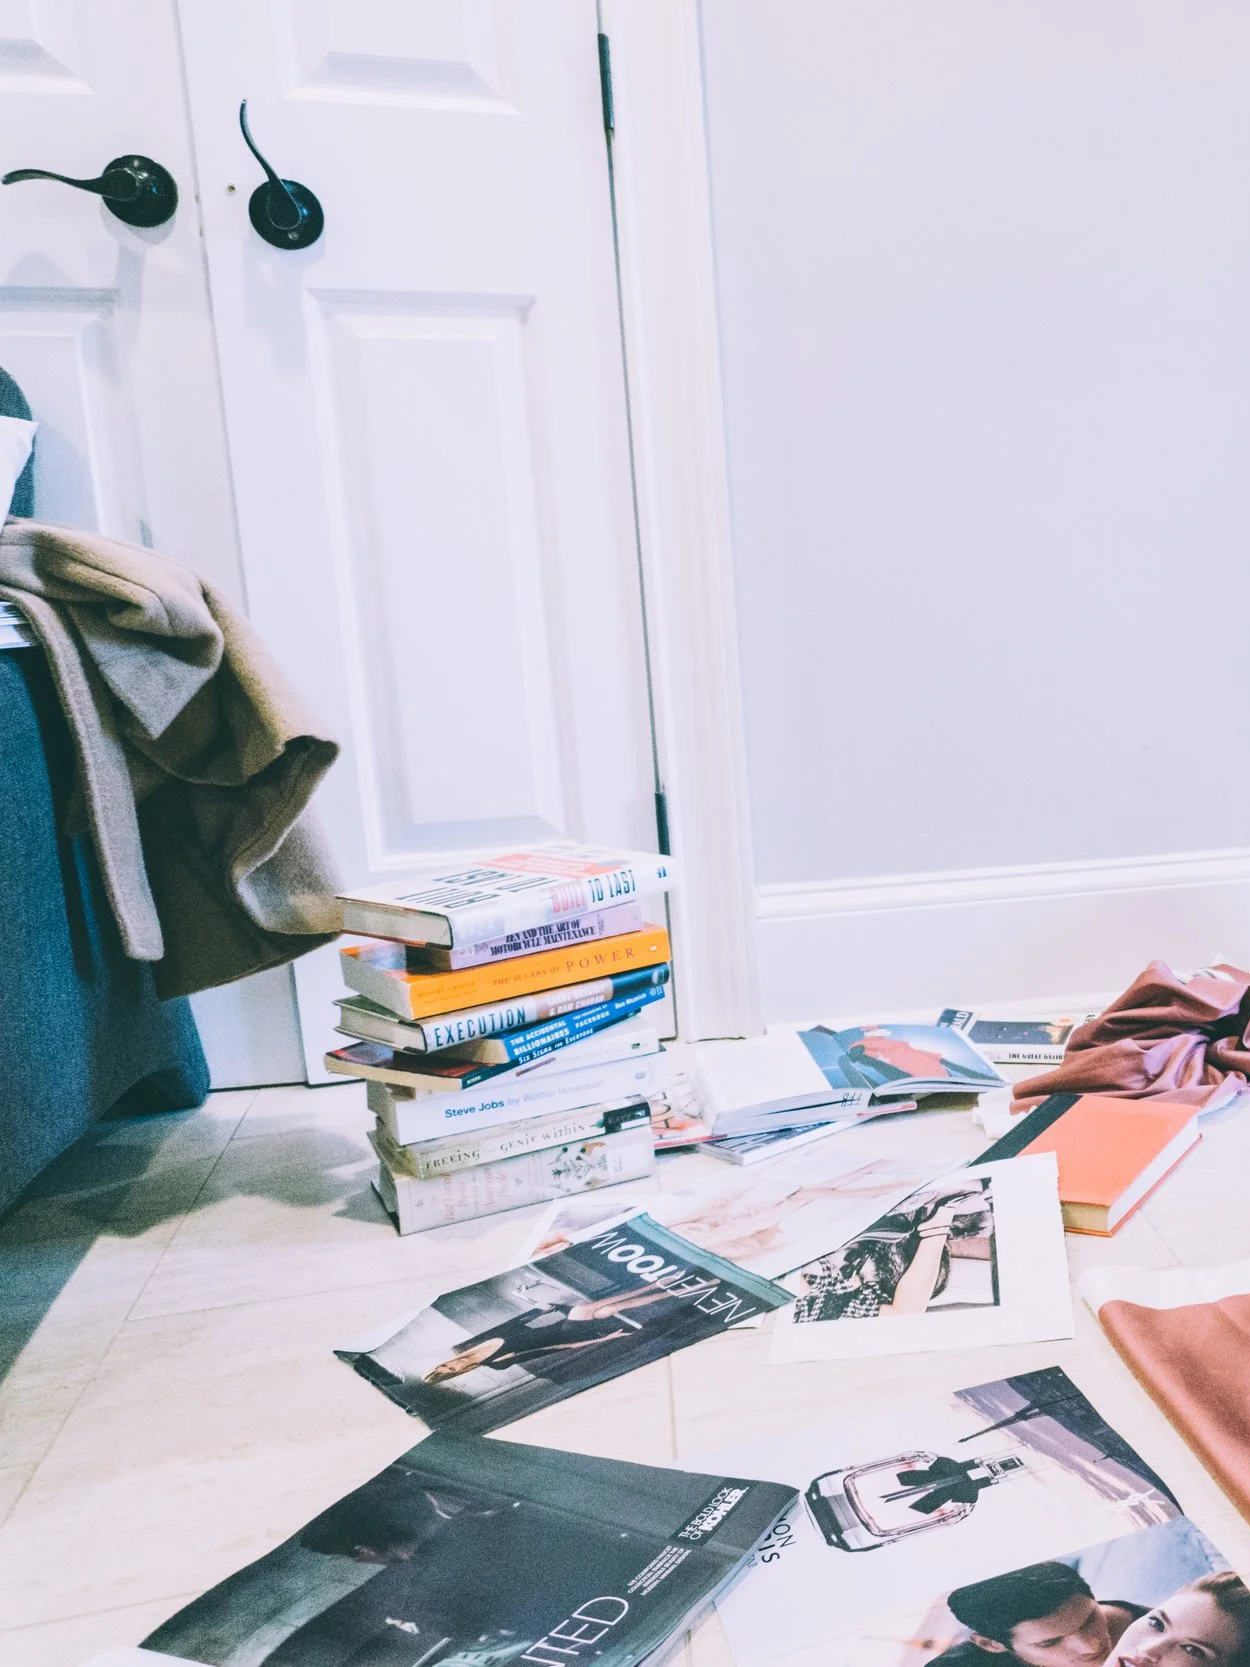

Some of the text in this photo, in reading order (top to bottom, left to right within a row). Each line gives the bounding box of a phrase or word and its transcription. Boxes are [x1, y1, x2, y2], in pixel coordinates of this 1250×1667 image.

[551, 869, 636, 914] BUILT TO LAST
[521, 928, 537, 940] AND
[538, 924, 554, 936] THE
[555, 921, 571, 932] ART
[571, 919, 581, 929] OF
[492, 977, 510, 986] THE
[565, 947, 636, 972] POWER
[434, 1006, 526, 1047] EXECUTION
[575, 1010, 610, 1028] FACEBOOK
[510, 1021, 567, 1046] THE ACCIDENTAL
[513, 1028, 570, 1055] BILLIONAIRES
[1043, 1053, 1065, 1061] GATSB
[445, 1105, 476, 1118] Steve
[478, 1099, 505, 1112] Jobs
[507, 1095, 520, 1107] by
[521, 1088, 556, 1103] Walter
[678, 1486, 734, 1538] THE BOLD LOOK
[689, 1529, 704, 1540] OF
